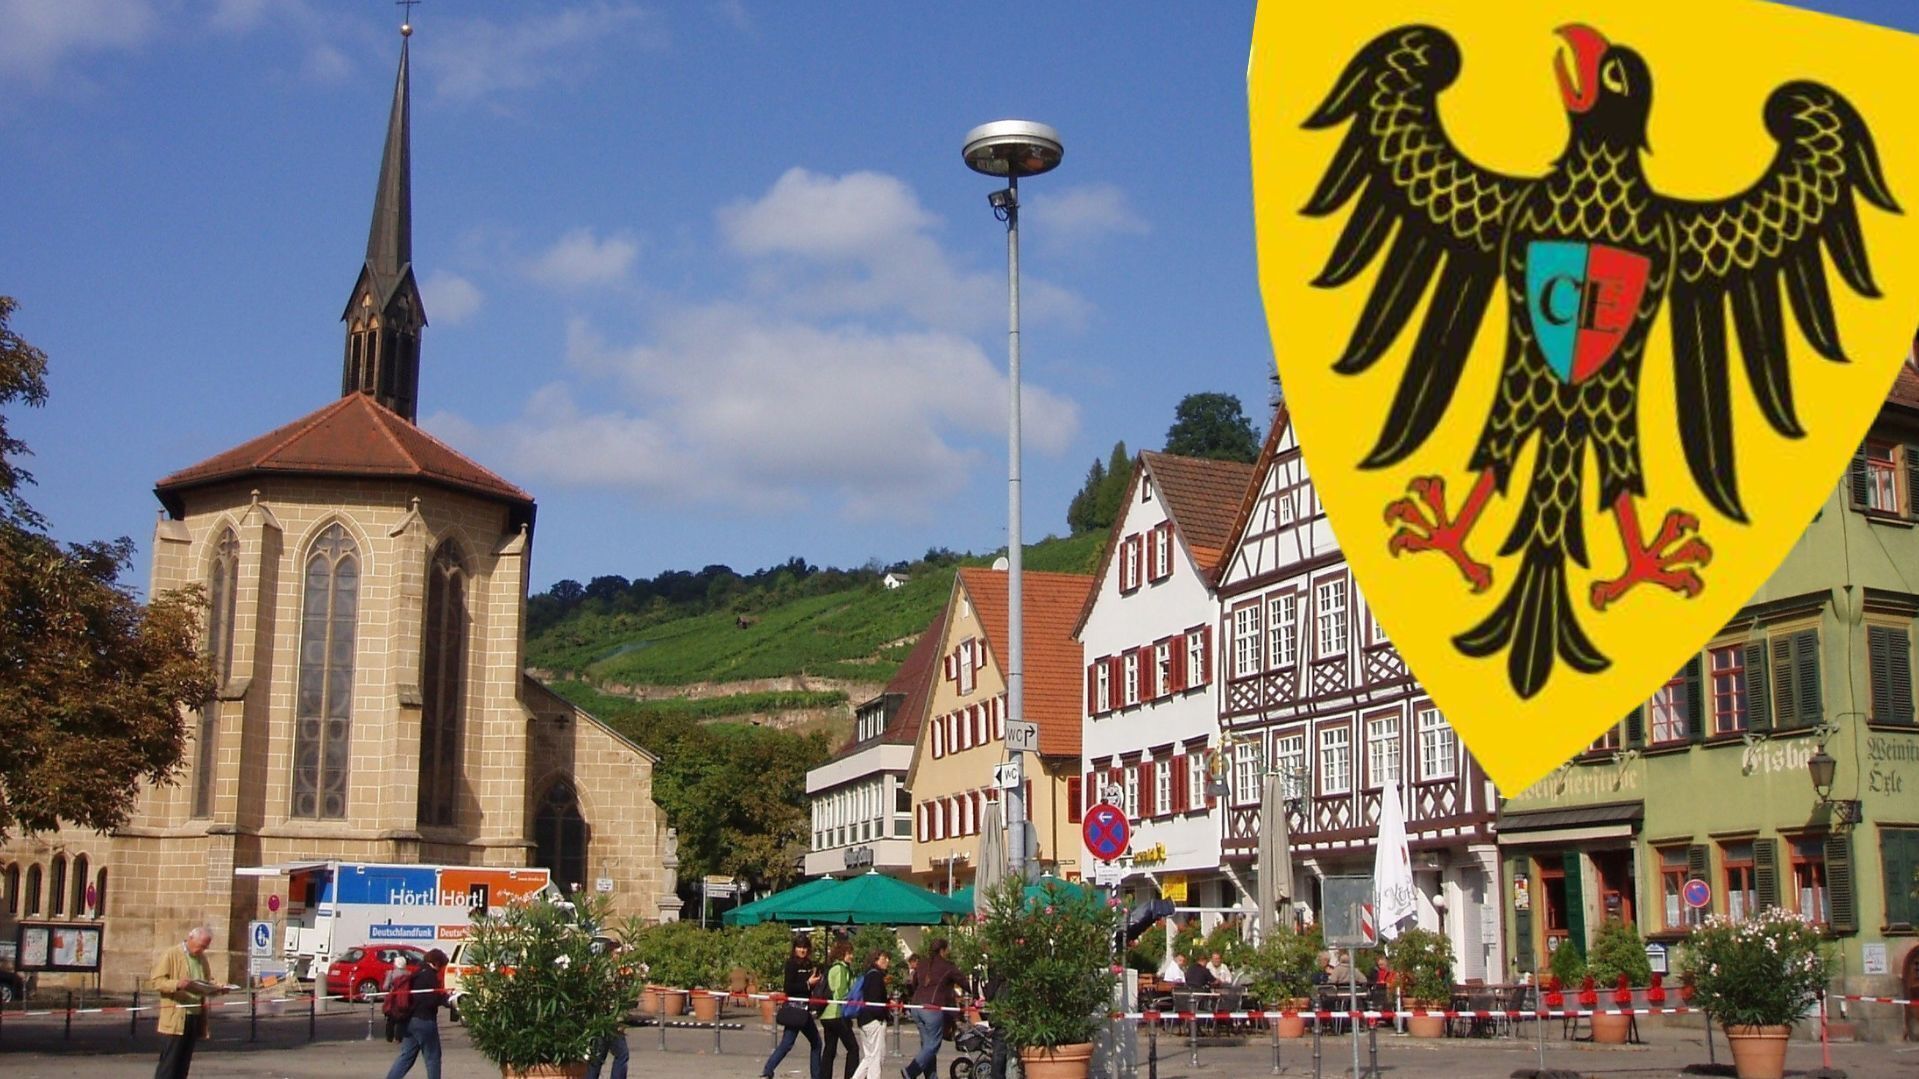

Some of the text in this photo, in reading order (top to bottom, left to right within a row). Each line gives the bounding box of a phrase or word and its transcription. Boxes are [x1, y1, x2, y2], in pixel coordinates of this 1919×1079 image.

[1007, 728, 1023, 742] WC
[1005, 768, 1017, 780] WC
[391, 888, 483, 908] Hört! Hört!
[372, 927, 432, 938] Deutschlandfunk
